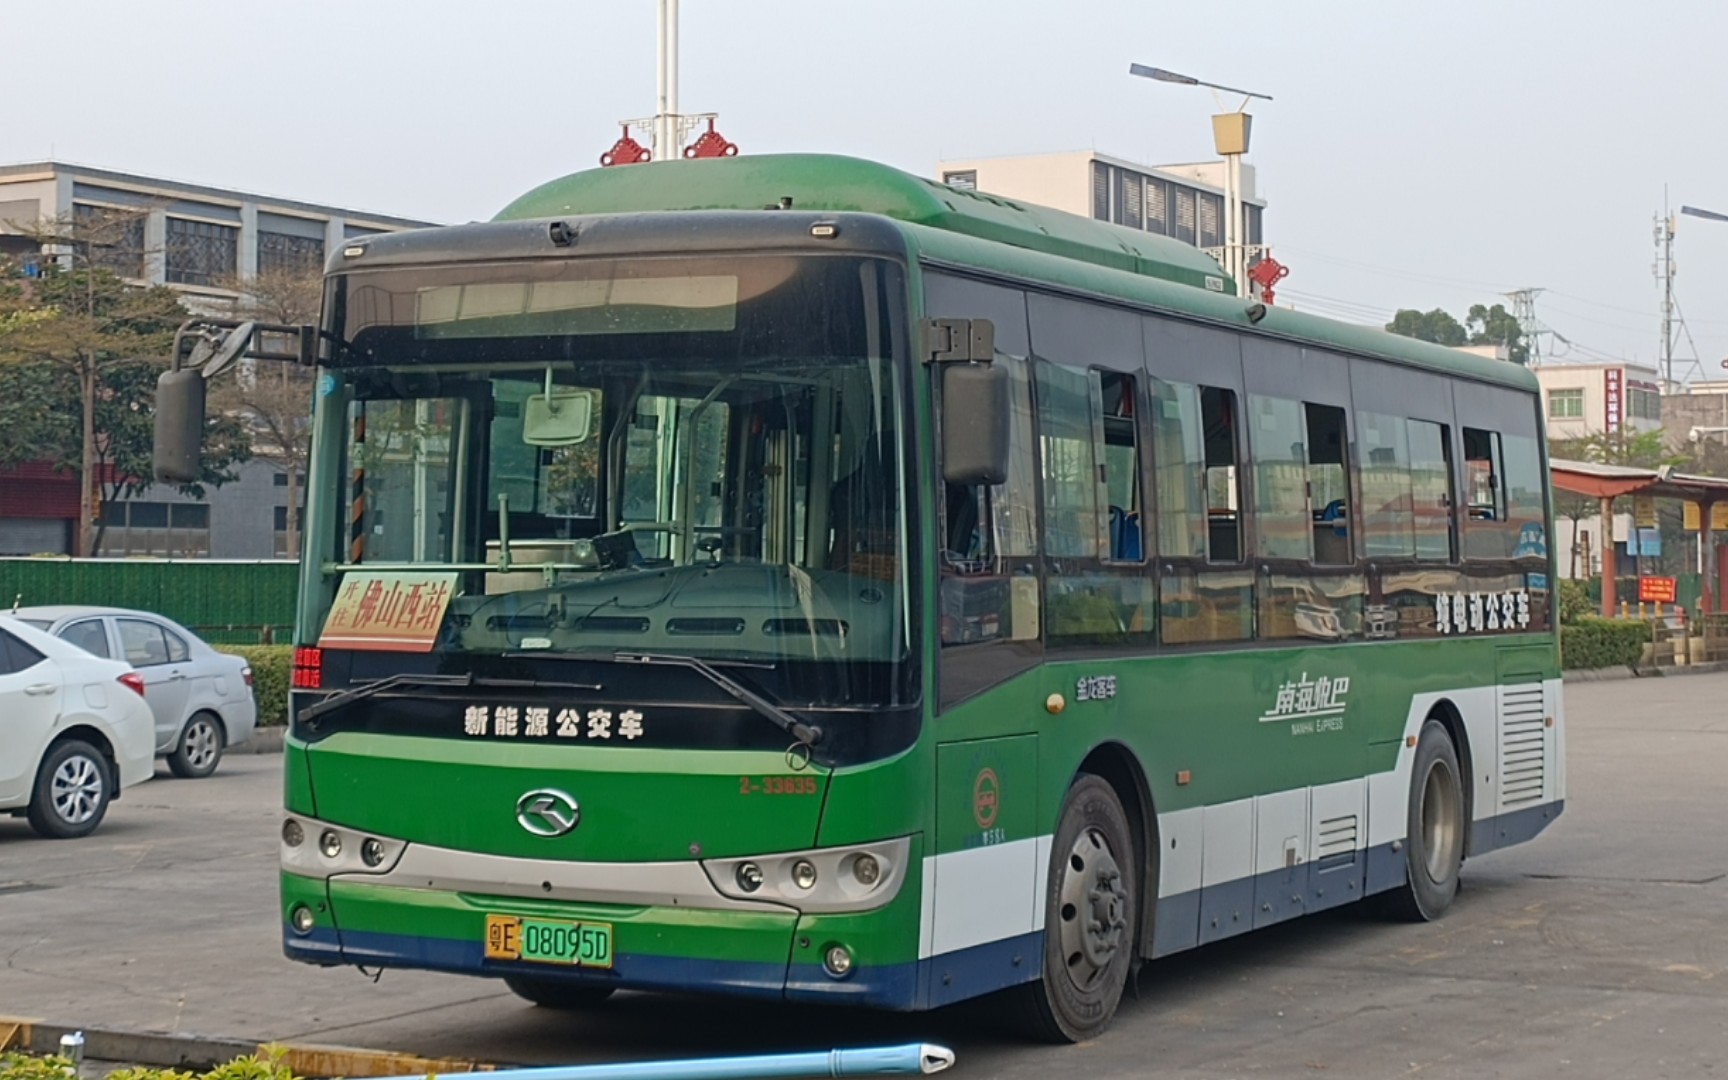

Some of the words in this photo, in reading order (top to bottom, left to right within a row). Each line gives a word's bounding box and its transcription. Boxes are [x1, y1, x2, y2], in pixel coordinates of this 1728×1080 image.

[352, 579, 447, 630] 佛山西站
[1076, 675, 1117, 701] 金龙客车
[1264, 671, 1350, 717] 南海快巴
[464, 705, 644, 740] 新能源公交车
